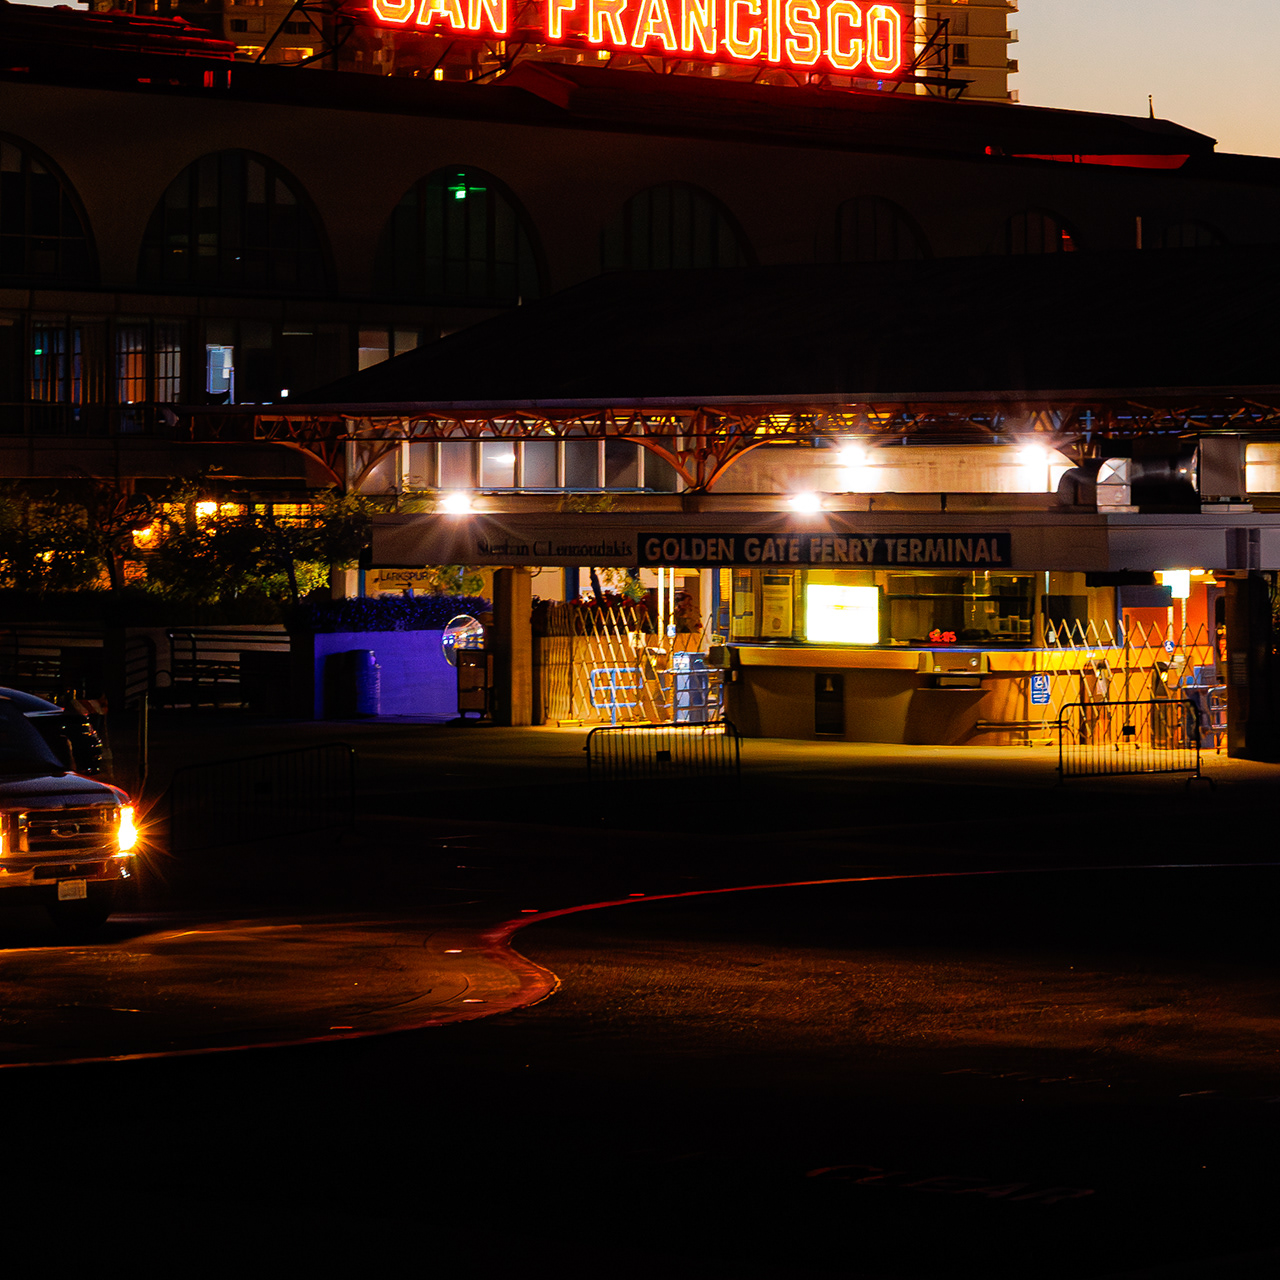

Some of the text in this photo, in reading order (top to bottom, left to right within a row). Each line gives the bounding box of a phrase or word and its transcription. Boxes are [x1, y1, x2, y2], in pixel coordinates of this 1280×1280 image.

[644, 536, 1003, 564] GOLDEN GATE FERRY TERMINAL
[379, 569, 429, 581] LARKSPUR
[804, 1163, 1097, 1206] CLEAR
